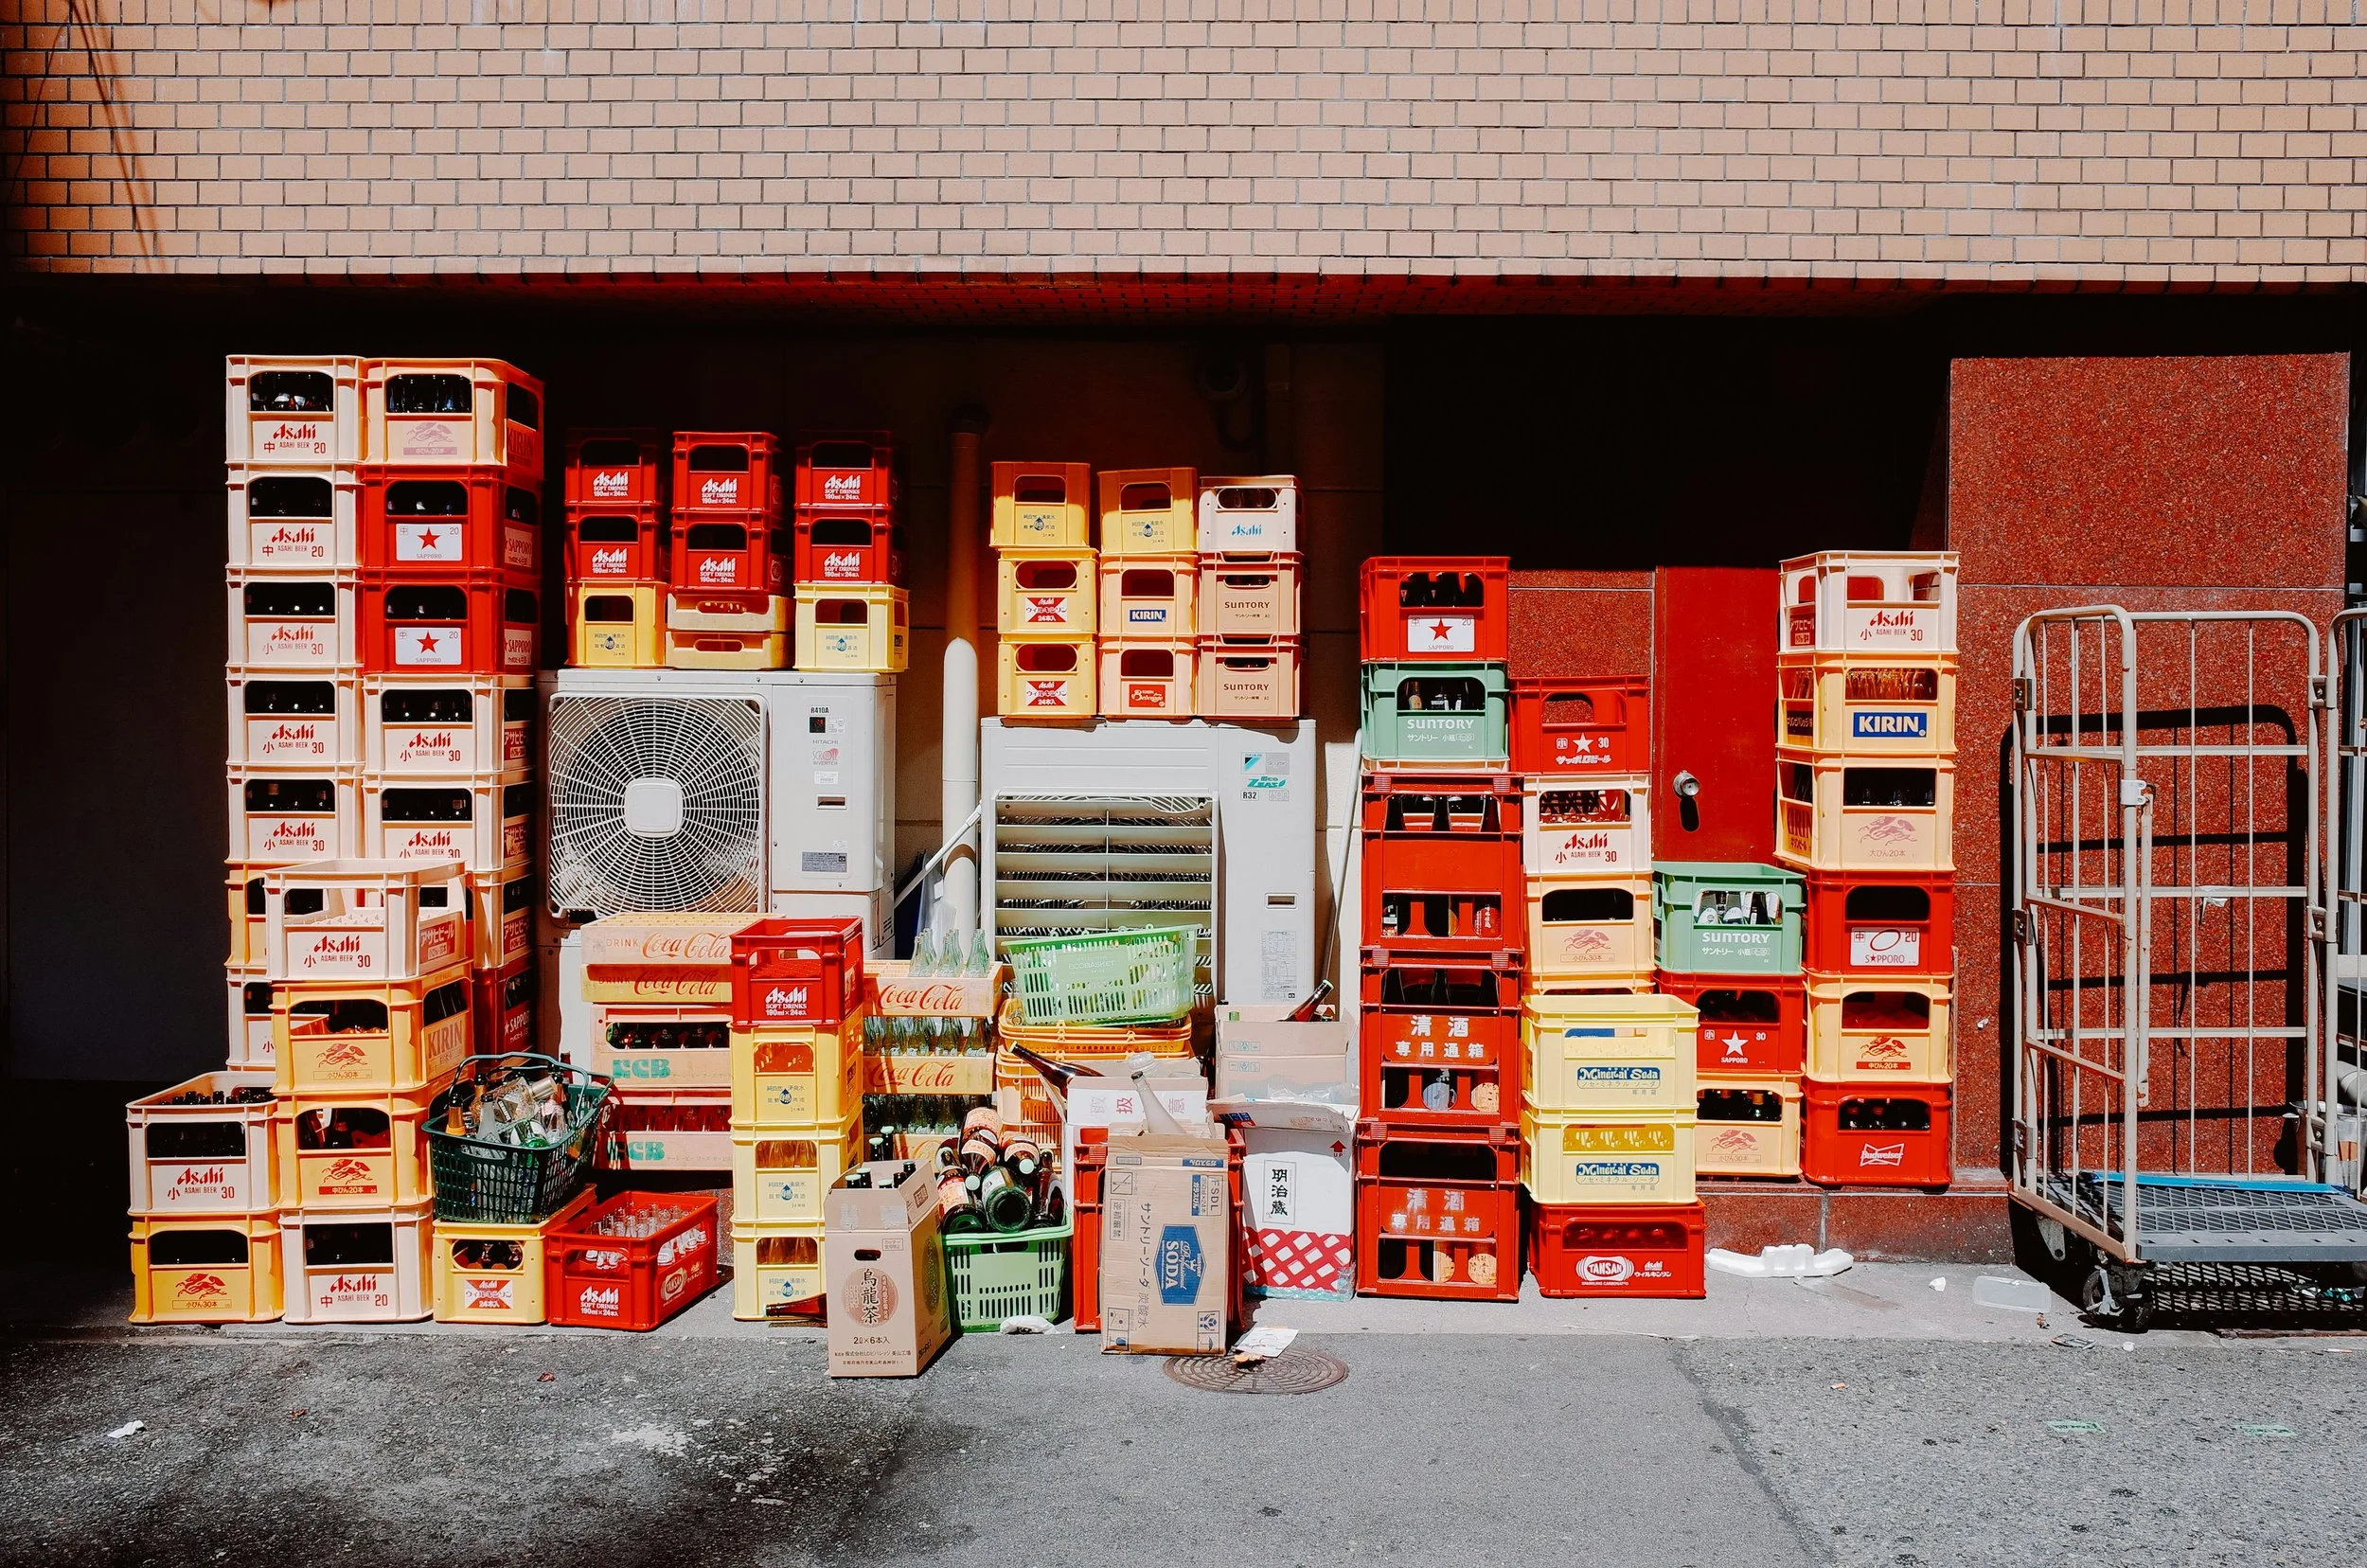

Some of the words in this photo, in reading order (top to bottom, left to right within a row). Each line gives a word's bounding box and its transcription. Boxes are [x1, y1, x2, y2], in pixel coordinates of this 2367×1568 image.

[273, 422, 316, 440] Asahi
[263, 441, 276, 454] 中
[313, 442, 327, 454] 20
[593, 472, 629, 486] Asahi
[701, 477, 738, 493] Asahi
[825, 474, 861, 490] Asahi
[271, 526, 315, 543] Asahi
[449, 526, 459, 536] 20
[1231, 524, 1262, 537] Asahi
[262, 544, 274, 558] 中
[311, 545, 324, 558] 20
[592, 548, 628, 563] Asahi
[700, 557, 736, 572] Asahi
[824, 552, 861, 567] Asahi
[1131, 611, 1164, 620] KIRIN
[1869, 610, 1914, 627] Asahi
[271, 625, 314, 641] Asahi
[448, 631, 458, 639] 20
[1860, 628, 1873, 641] 小
[1910, 629, 1924, 642] 30
[262, 642, 274, 654] 小
[295, 642, 308, 650] BEER
[311, 643, 324, 655] 30
[272, 724, 315, 739] Asahi
[1859, 716, 1918, 733] KIRIN
[408, 732, 452, 748] Asahi
[1407, 733, 1438, 742] サントリー
[1598, 738, 1610, 748] 30
[263, 741, 275, 754] 小
[311, 741, 325, 754] 30
[400, 750, 412, 762] 小
[448, 750, 461, 761] 30
[1242, 792, 1257, 800] R32
[273, 821, 315, 838] Asahi
[263, 838, 276, 850] 小
[312, 840, 325, 852] 30
[408, 830, 451, 847] Asahi
[1564, 832, 1609, 850] Asahi
[1555, 851, 1567, 864] 小
[1605, 850, 1617, 863] 30
[1869, 849, 1906, 858] 大びん20本
[420, 925, 454, 947] アサヒビール
[606, 938, 639, 947] DRINK
[1856, 931, 1864, 942] 中
[1905, 931, 1917, 943] 20
[313, 935, 361, 953] Asahi
[1701, 947, 1735, 955] サントリー
[303, 954, 316, 968] 小
[357, 954, 371, 968] 30
[598, 976, 631, 985] DRINK
[765, 987, 808, 1004] Asahi
[1410, 1014, 1469, 1038] 清酒
[428, 1021, 463, 1060] KIRIN
[1755, 1032, 1767, 1041] 30
[1396, 1042, 1484, 1059] 専用通箱
[1578, 1068, 1628, 1080] Mineral
[1630, 1068, 1658, 1079] Soda
[177, 1167, 224, 1185] Asahi
[1577, 1164, 1628, 1176] Mineral
[1628, 1164, 1657, 1175] Soda
[167, 1187, 180, 1201] 小
[221, 1185, 235, 1199] 30
[1211, 1180, 1220, 1212] FSDL
[1270, 1168, 1289, 1216] 明治蔵
[1405, 1187, 1465, 1211] 清酒
[1391, 1213, 1481, 1233] 専用通箱
[1166, 1240, 1180, 1290] SODA
[1589, 1262, 1622, 1275] TANSAN
[329, 1274, 378, 1292] Asahi
[320, 1295, 333, 1308] 中
[337, 1293, 355, 1302] ASAHI
[374, 1293, 388, 1307] 20
[579, 1286, 619, 1303] Asahi
[861, 1269, 881, 1325] 烏龍茶
[596, 1302, 619, 1310] DRINKS
[1137, 1292, 1149, 1328] 炭酸水
